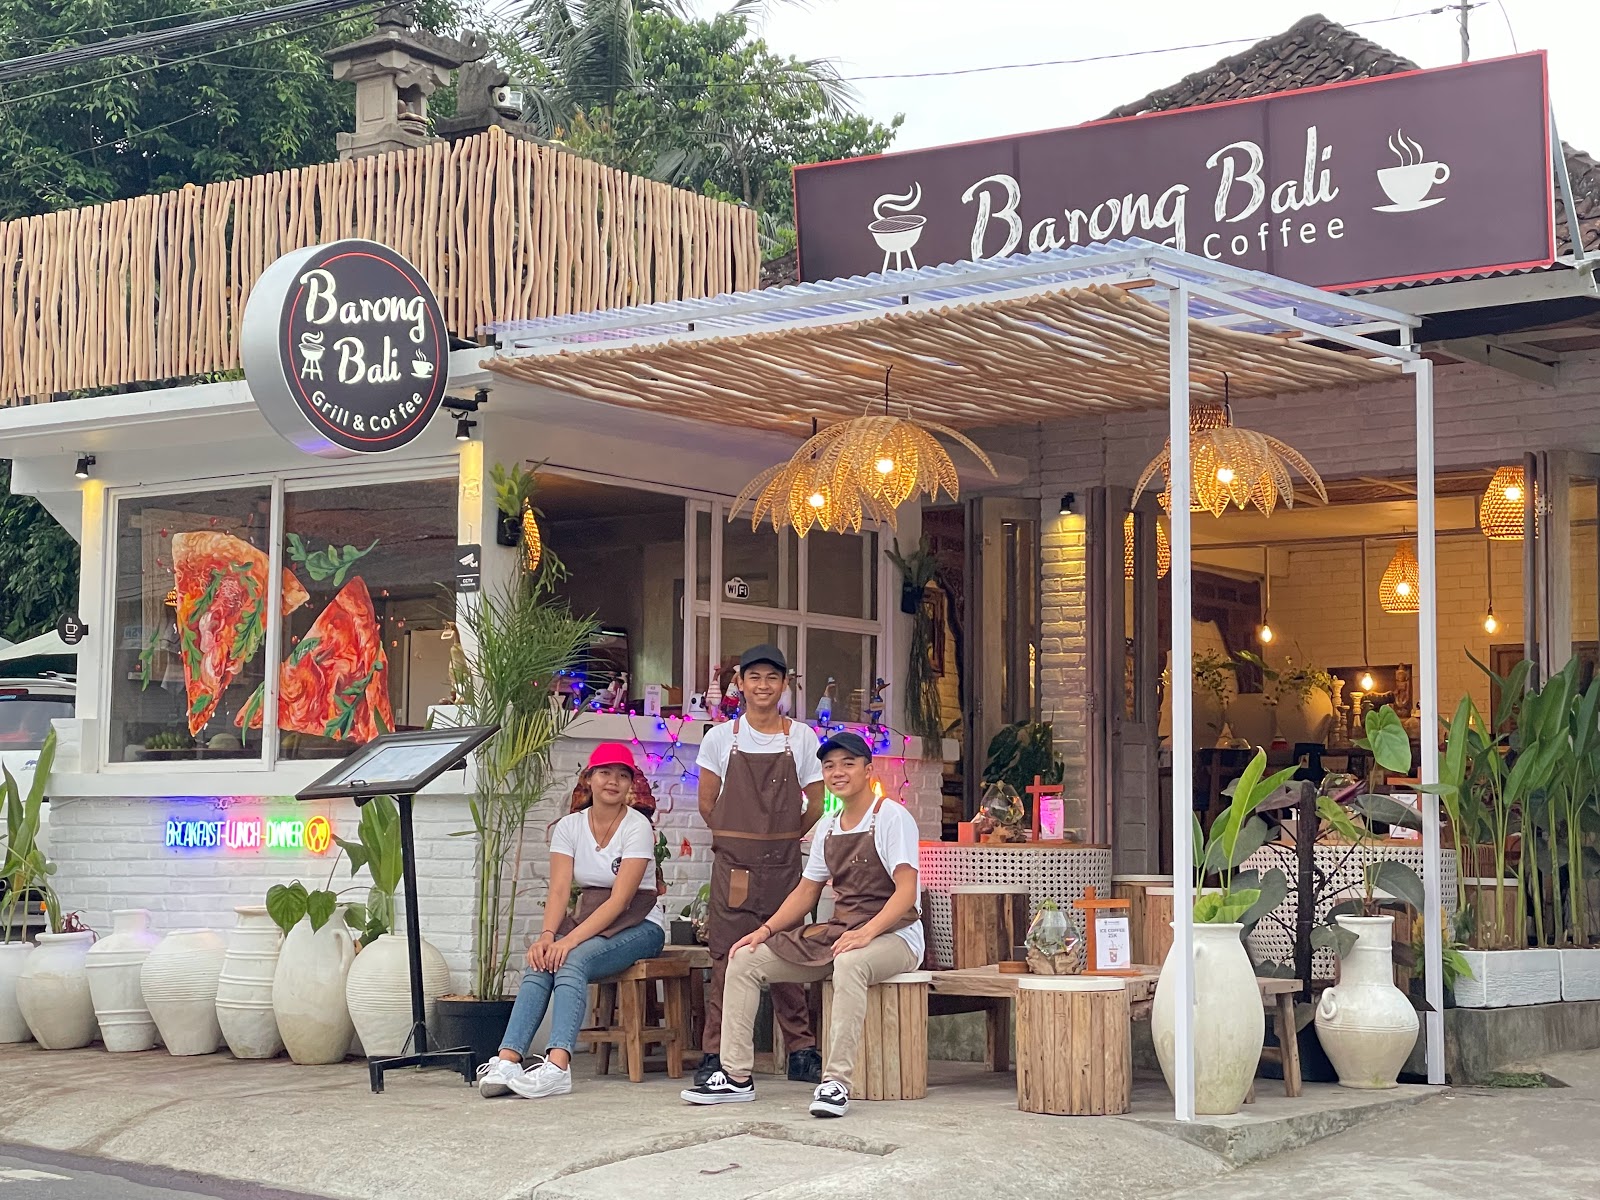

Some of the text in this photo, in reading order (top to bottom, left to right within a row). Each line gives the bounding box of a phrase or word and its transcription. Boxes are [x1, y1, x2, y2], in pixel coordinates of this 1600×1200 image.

[962, 125, 1340, 262] Barong Bali
[1203, 218, 1344, 260] Coffee
[300, 269, 426, 343] Barong
[333, 335, 401, 384] Bali
[312, 390, 424, 432] Grill & Coffee
